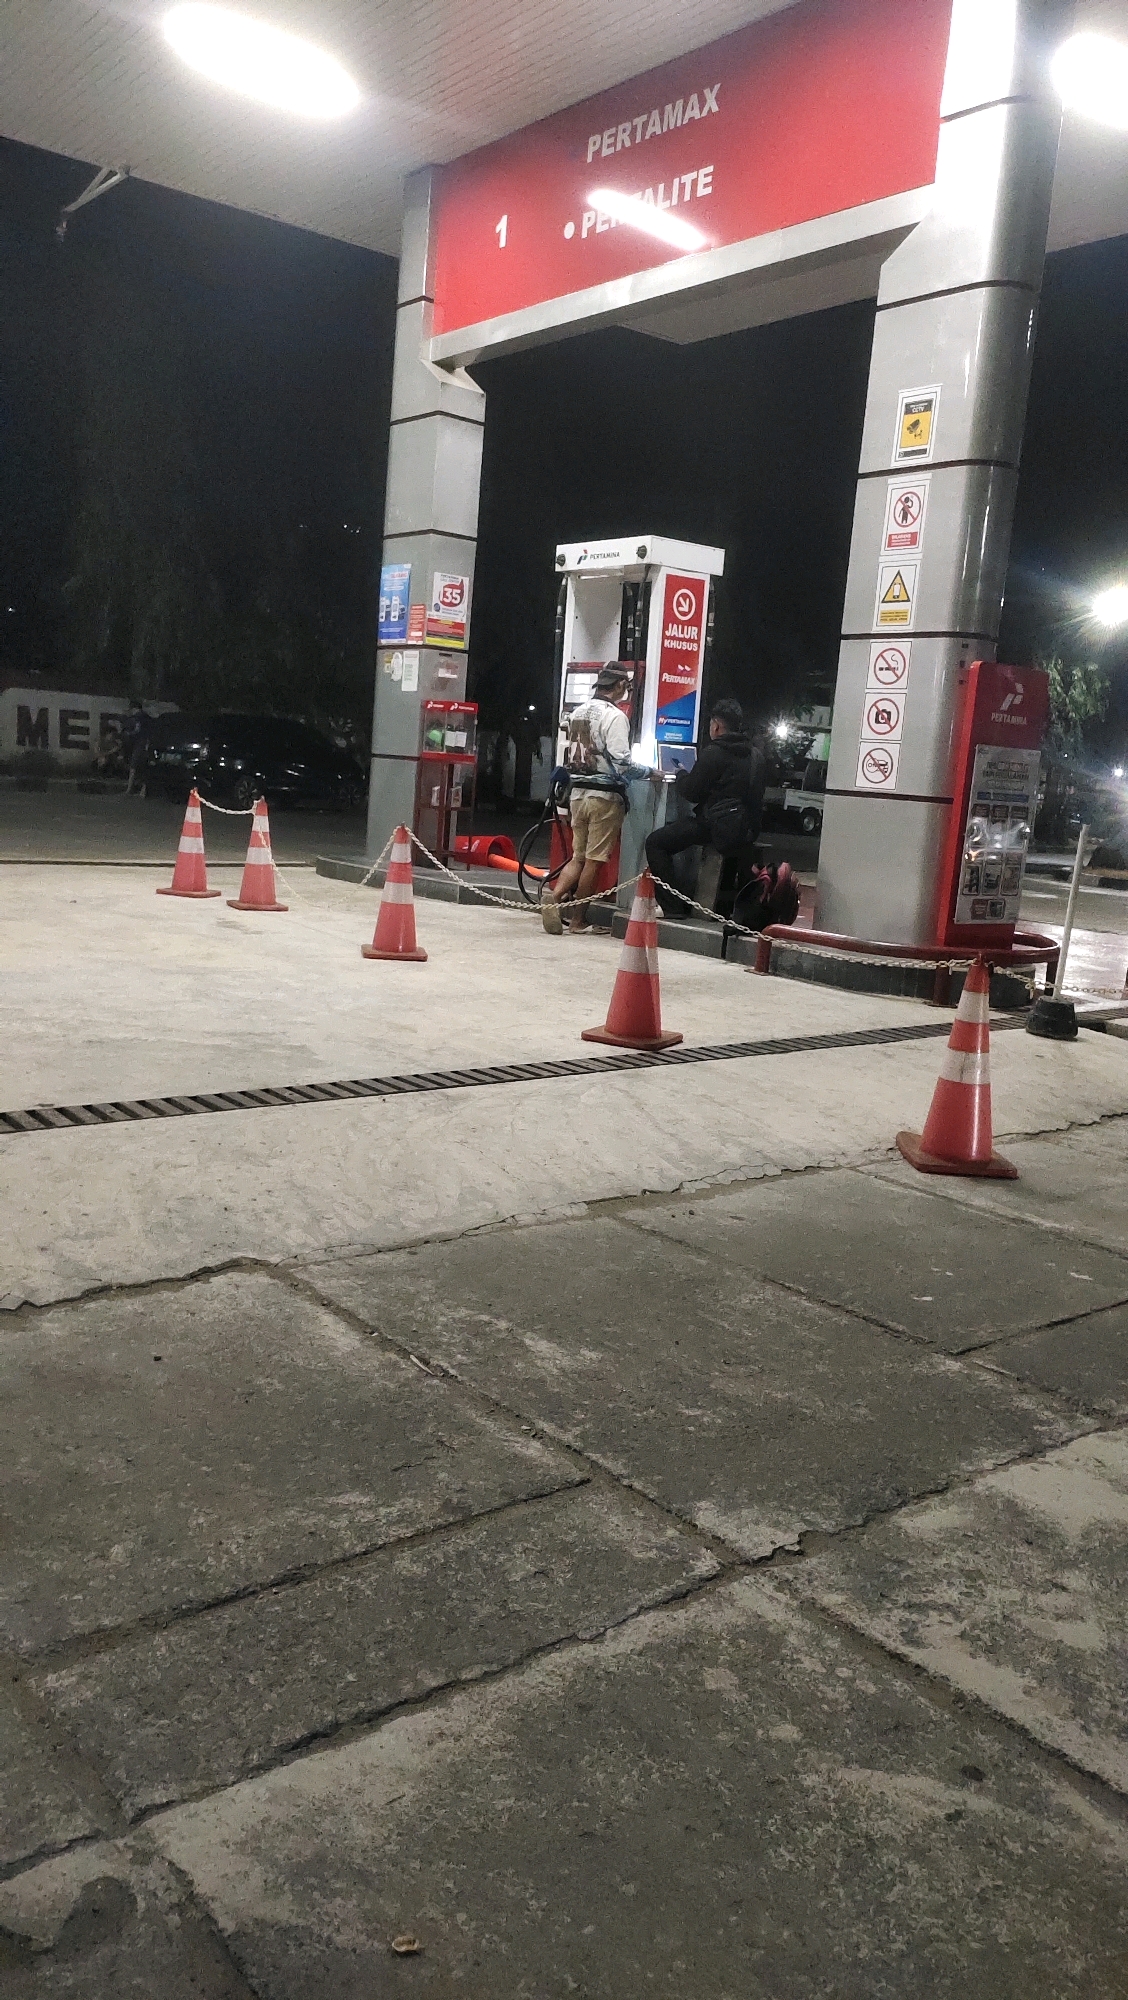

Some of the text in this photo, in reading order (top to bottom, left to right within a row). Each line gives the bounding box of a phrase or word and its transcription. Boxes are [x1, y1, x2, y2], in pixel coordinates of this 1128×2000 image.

[587, 83, 722, 163] PERTAMAX
[581, 165, 715, 239] PEALITE
[495, 214, 508, 248] 1
[590, 552, 620, 560] PERTAMINA
[665, 623, 698, 640] JALUR
[664, 638, 698, 651] KHUSUS
[991, 712, 1027, 725] PERTAMINA
